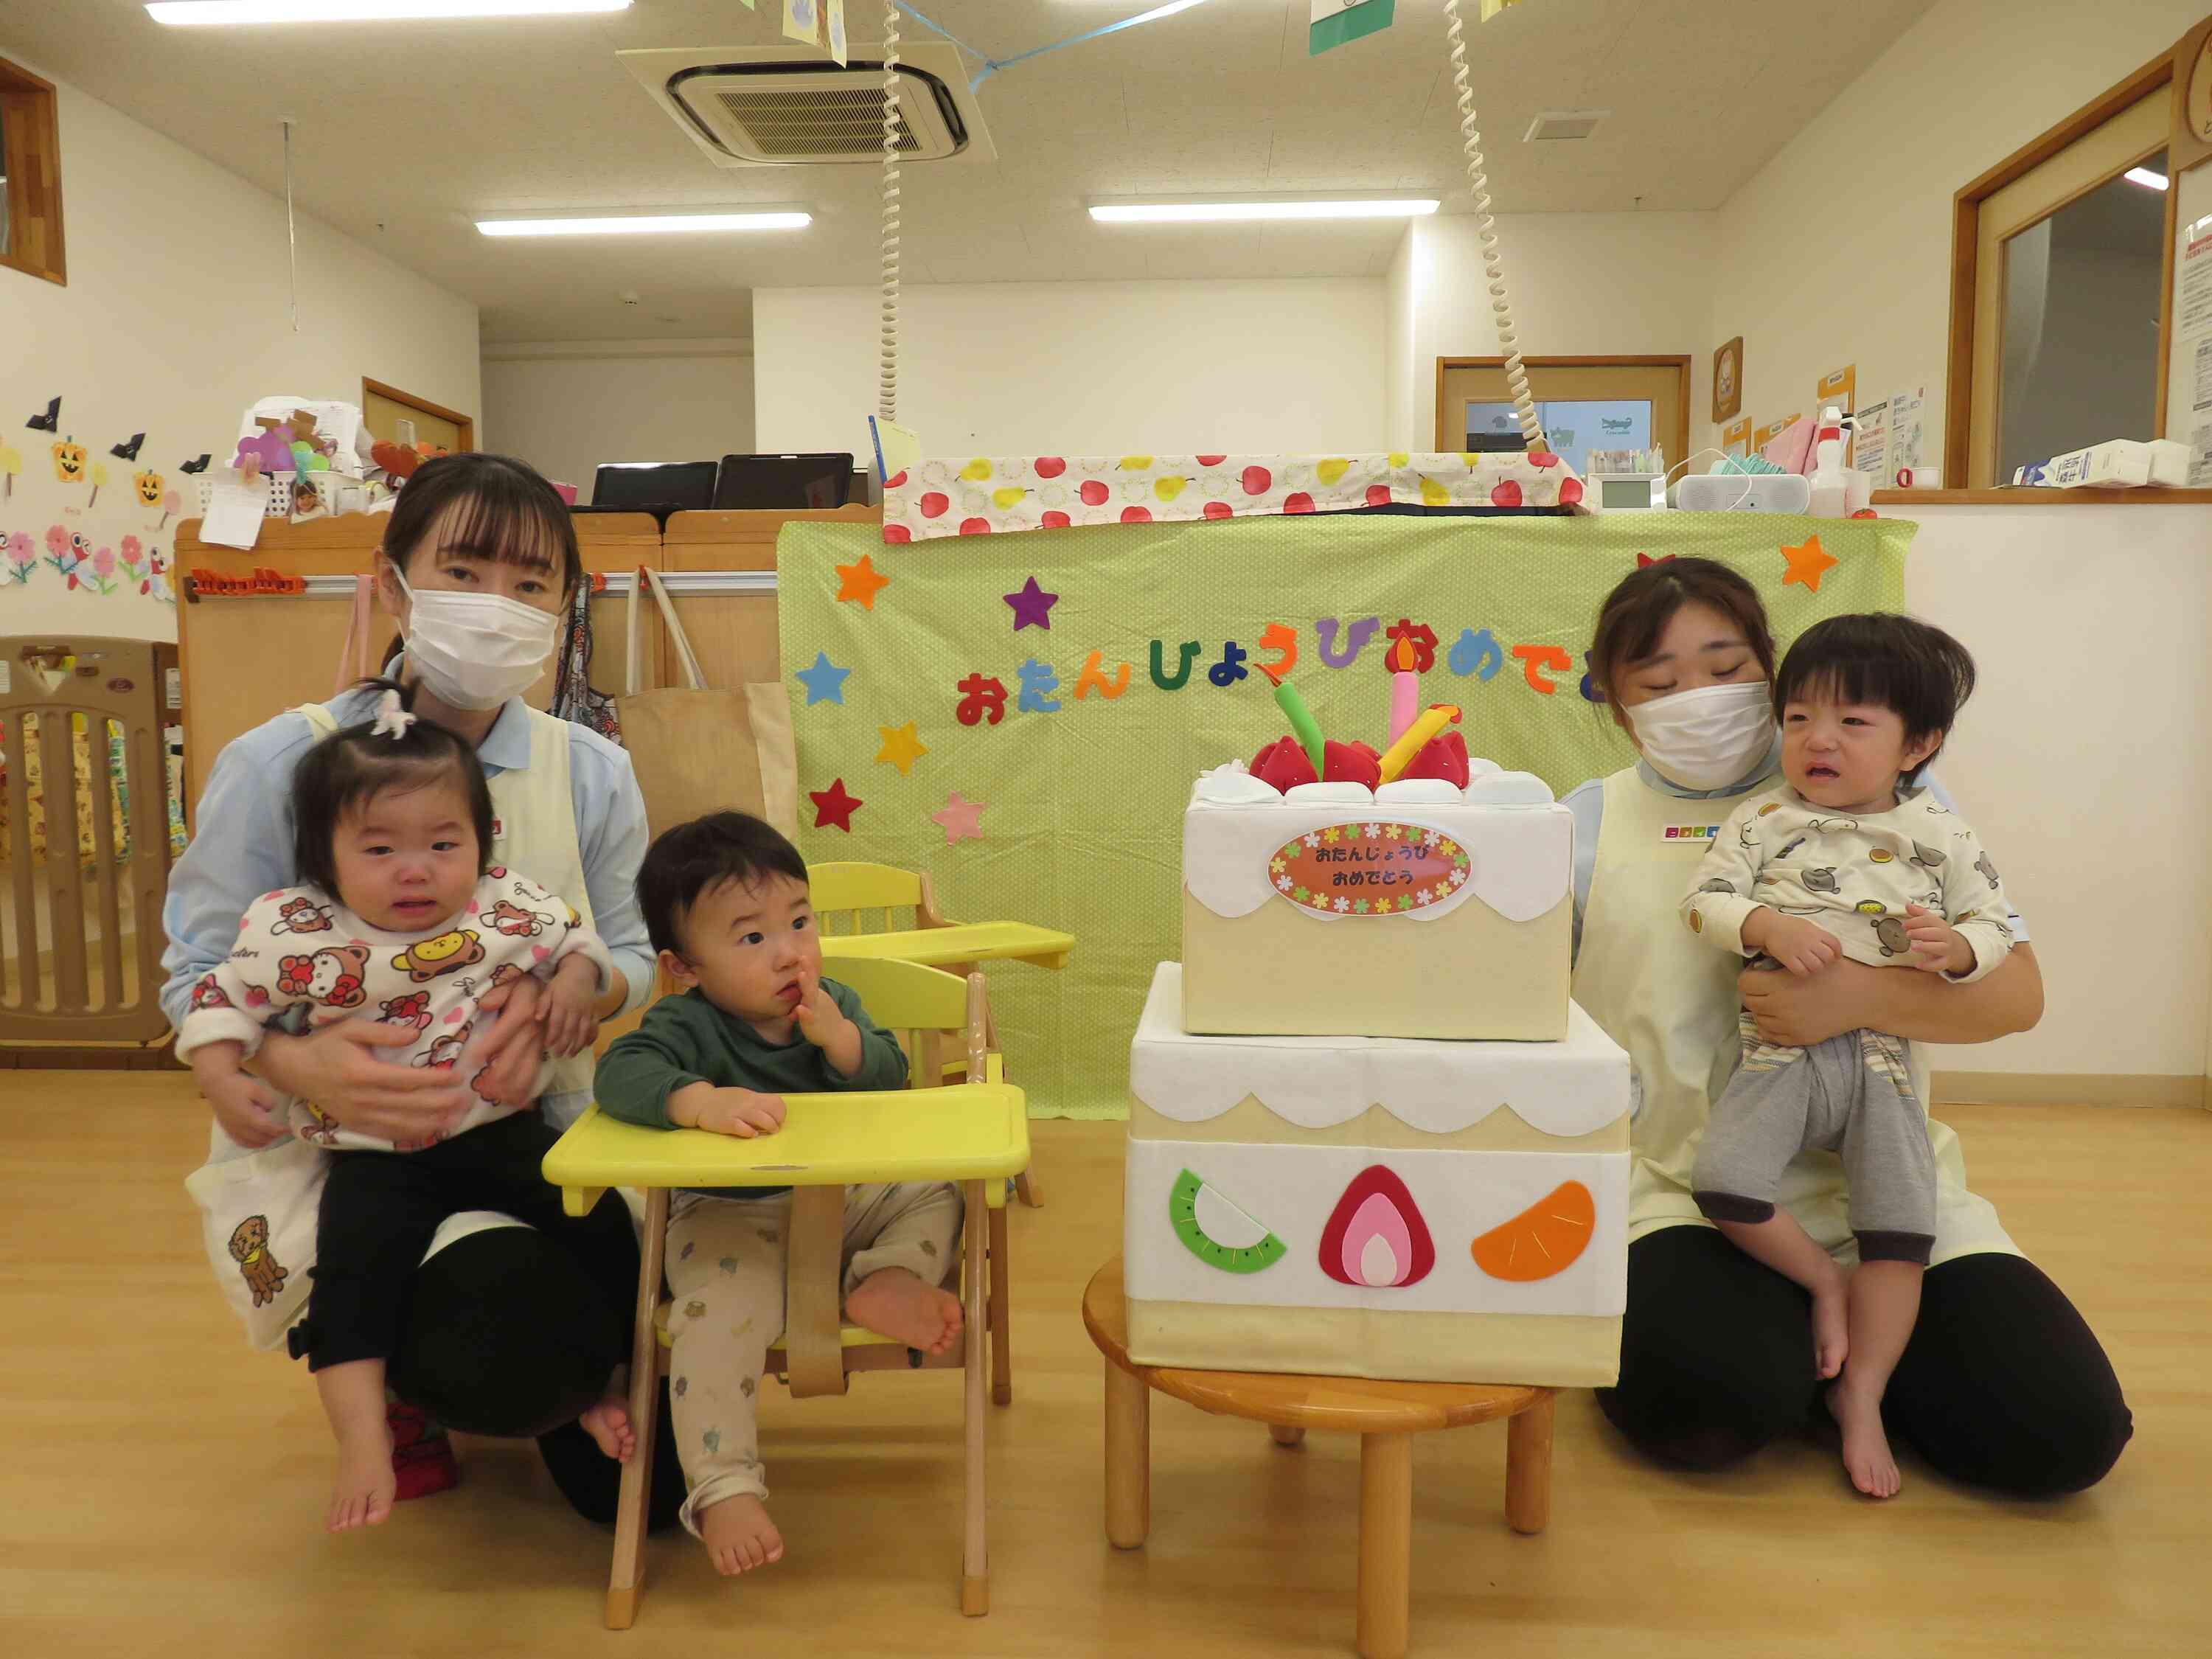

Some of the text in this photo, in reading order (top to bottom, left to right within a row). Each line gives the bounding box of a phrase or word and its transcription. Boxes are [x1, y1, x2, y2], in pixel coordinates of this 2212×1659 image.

[1315, 845, 1429, 862] おたんじょうび
[1332, 870, 1414, 886] おめでとう
